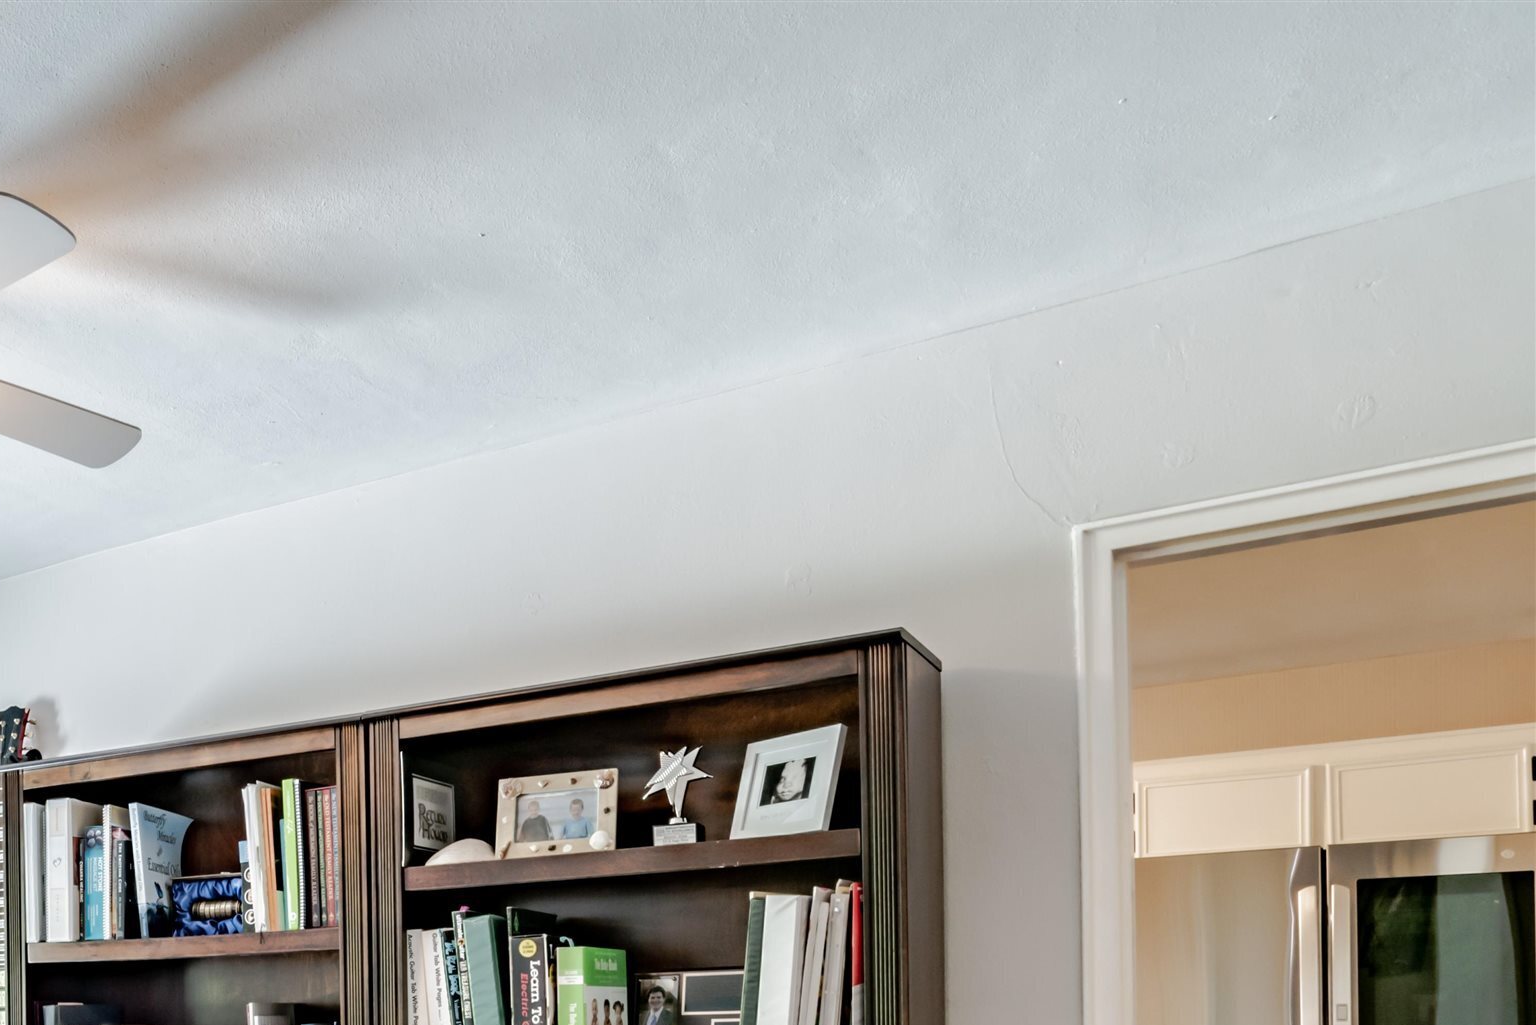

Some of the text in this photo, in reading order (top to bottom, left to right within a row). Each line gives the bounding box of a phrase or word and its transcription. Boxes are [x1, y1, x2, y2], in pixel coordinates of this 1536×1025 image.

[446, 955, 458, 974] REAL
[448, 974, 462, 995] BOOK
[530, 960, 541, 1003] Learn
[520, 973, 529, 1017] Electric
[453, 999, 461, 1019] Volume
[531, 1006, 542, 1024] To
